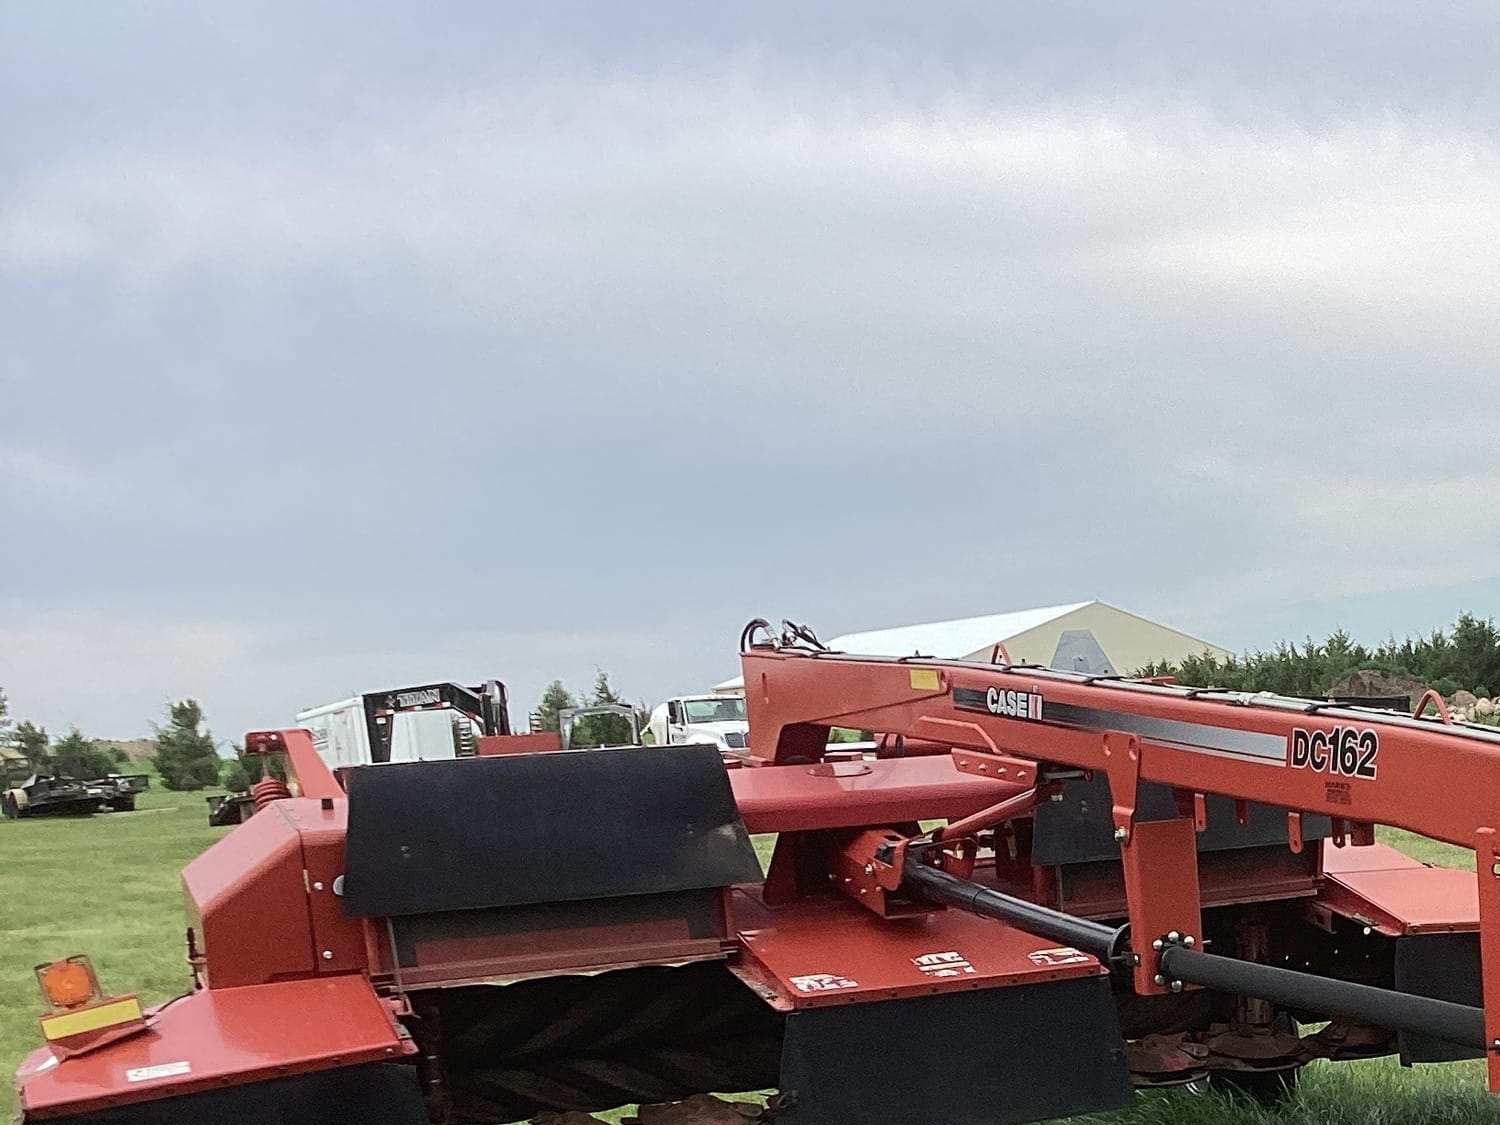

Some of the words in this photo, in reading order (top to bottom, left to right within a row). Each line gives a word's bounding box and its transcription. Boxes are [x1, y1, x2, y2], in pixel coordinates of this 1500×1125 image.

[396, 688, 441, 707] TITAN
[987, 687, 1027, 718] CASE
[1291, 725, 1379, 780] DC162
